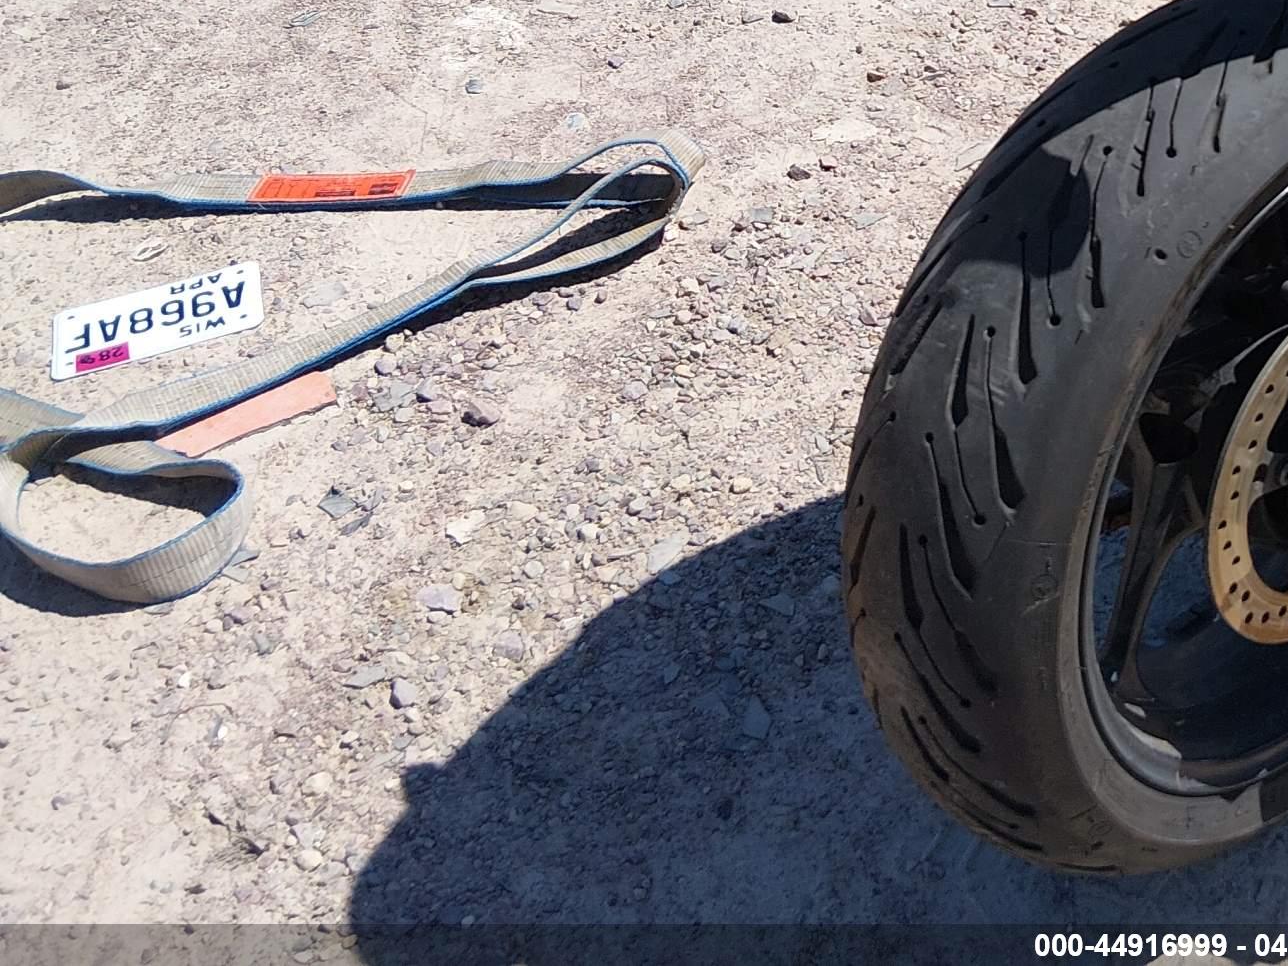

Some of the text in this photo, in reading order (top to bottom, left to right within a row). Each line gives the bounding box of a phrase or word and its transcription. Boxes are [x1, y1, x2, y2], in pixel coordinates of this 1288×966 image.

[170, 272, 224, 295] APR
[65, 280, 246, 354] A968AF
[180, 315, 226, 338] WIS
